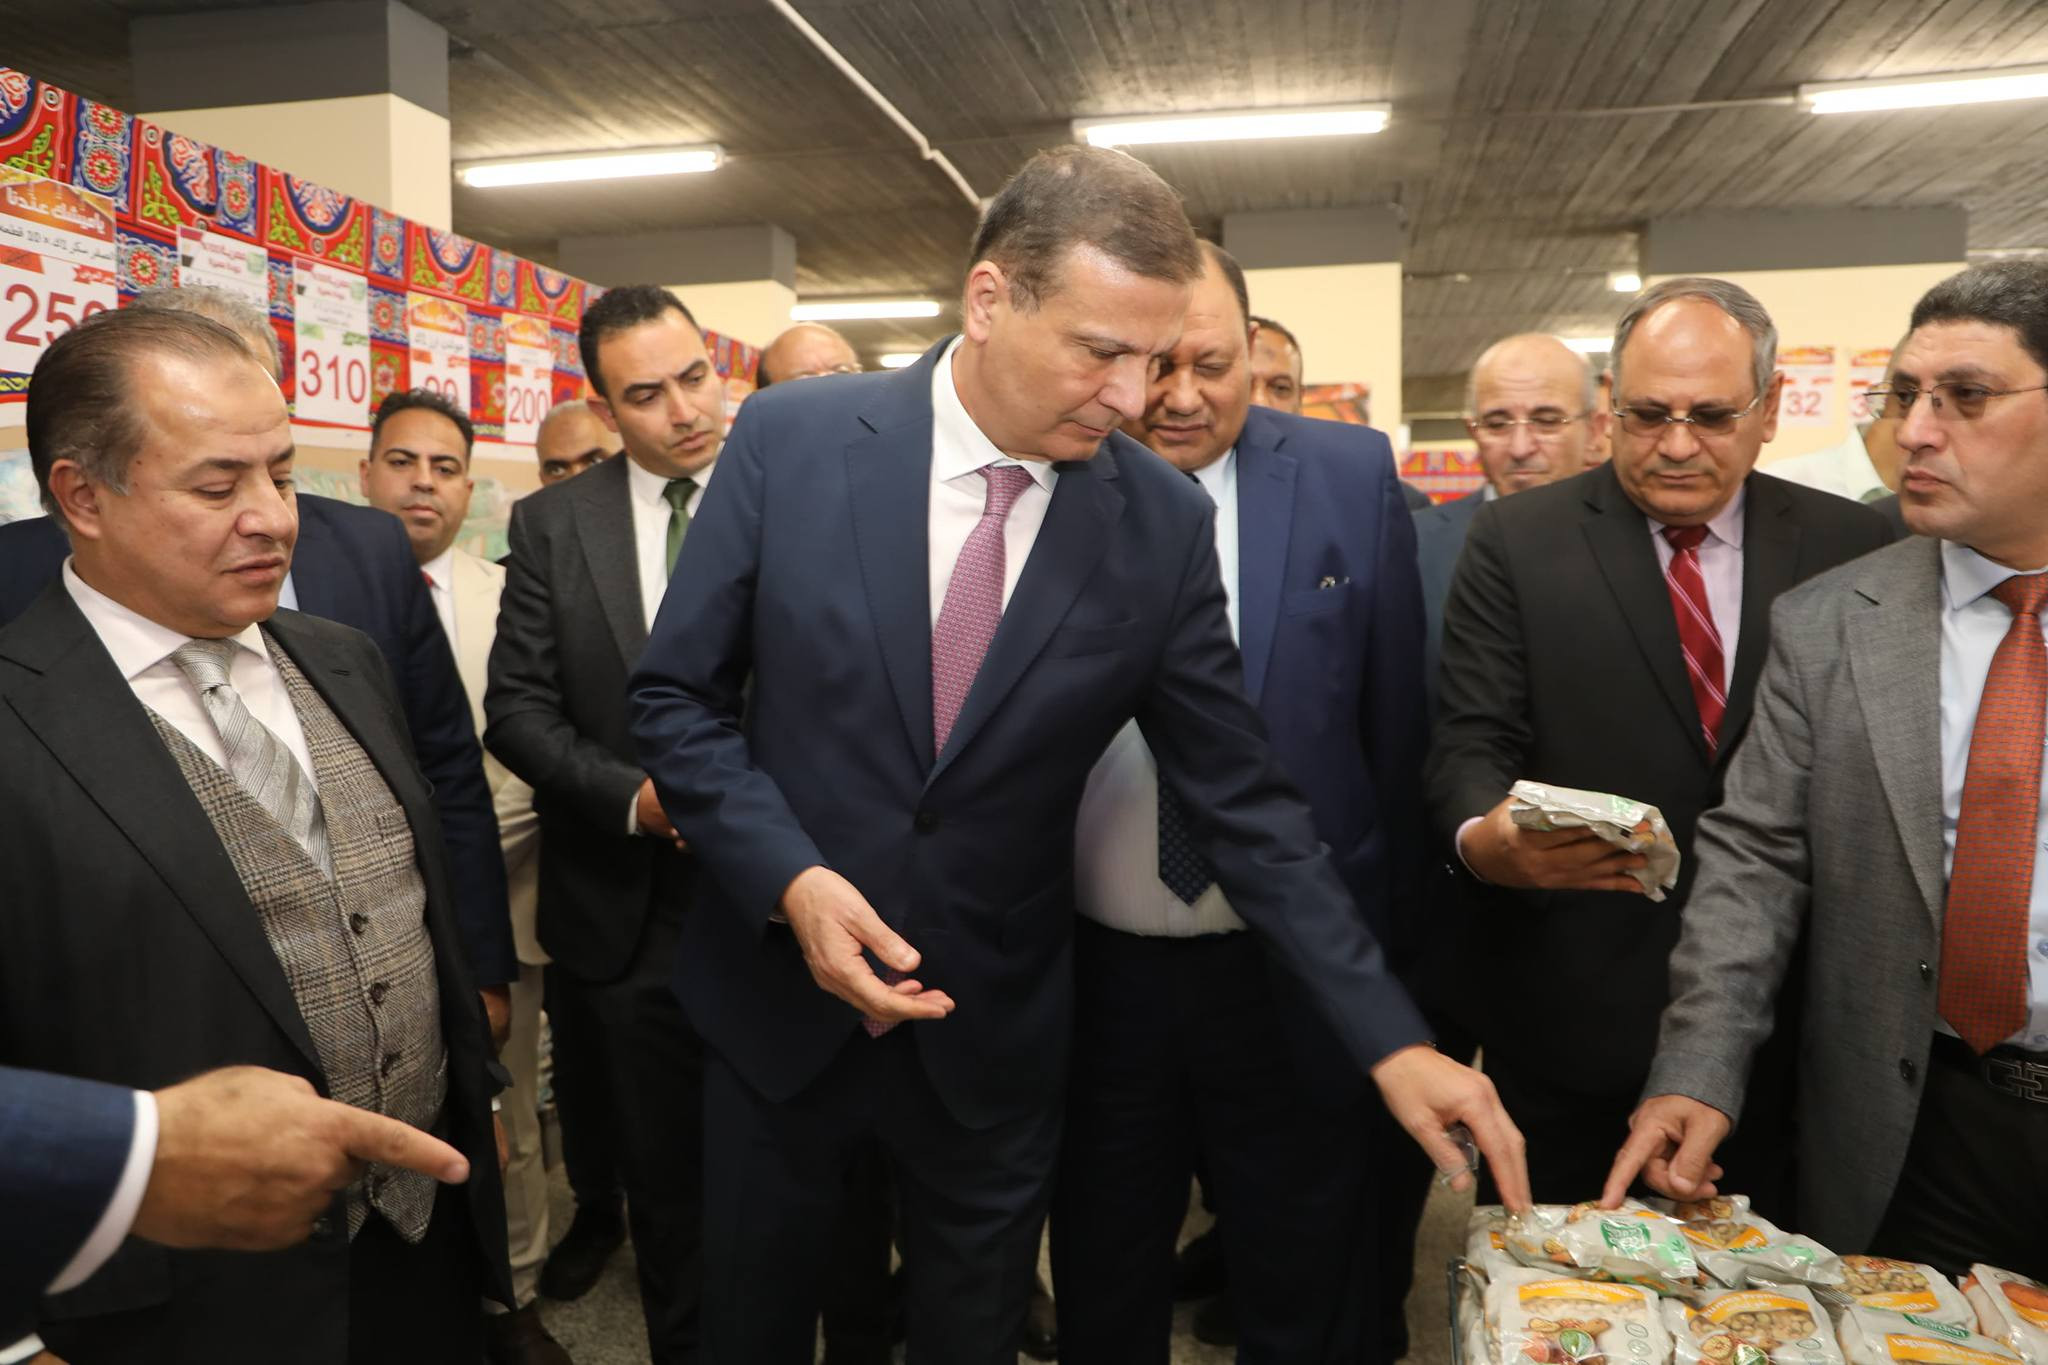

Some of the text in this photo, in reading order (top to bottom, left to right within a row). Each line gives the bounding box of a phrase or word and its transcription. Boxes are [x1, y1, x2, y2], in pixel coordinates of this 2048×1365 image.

[6, 283, 107, 346] 25
[302, 350, 366, 404] 310
[509, 386, 548, 424] 200
[1786, 391, 1821, 416] 32
